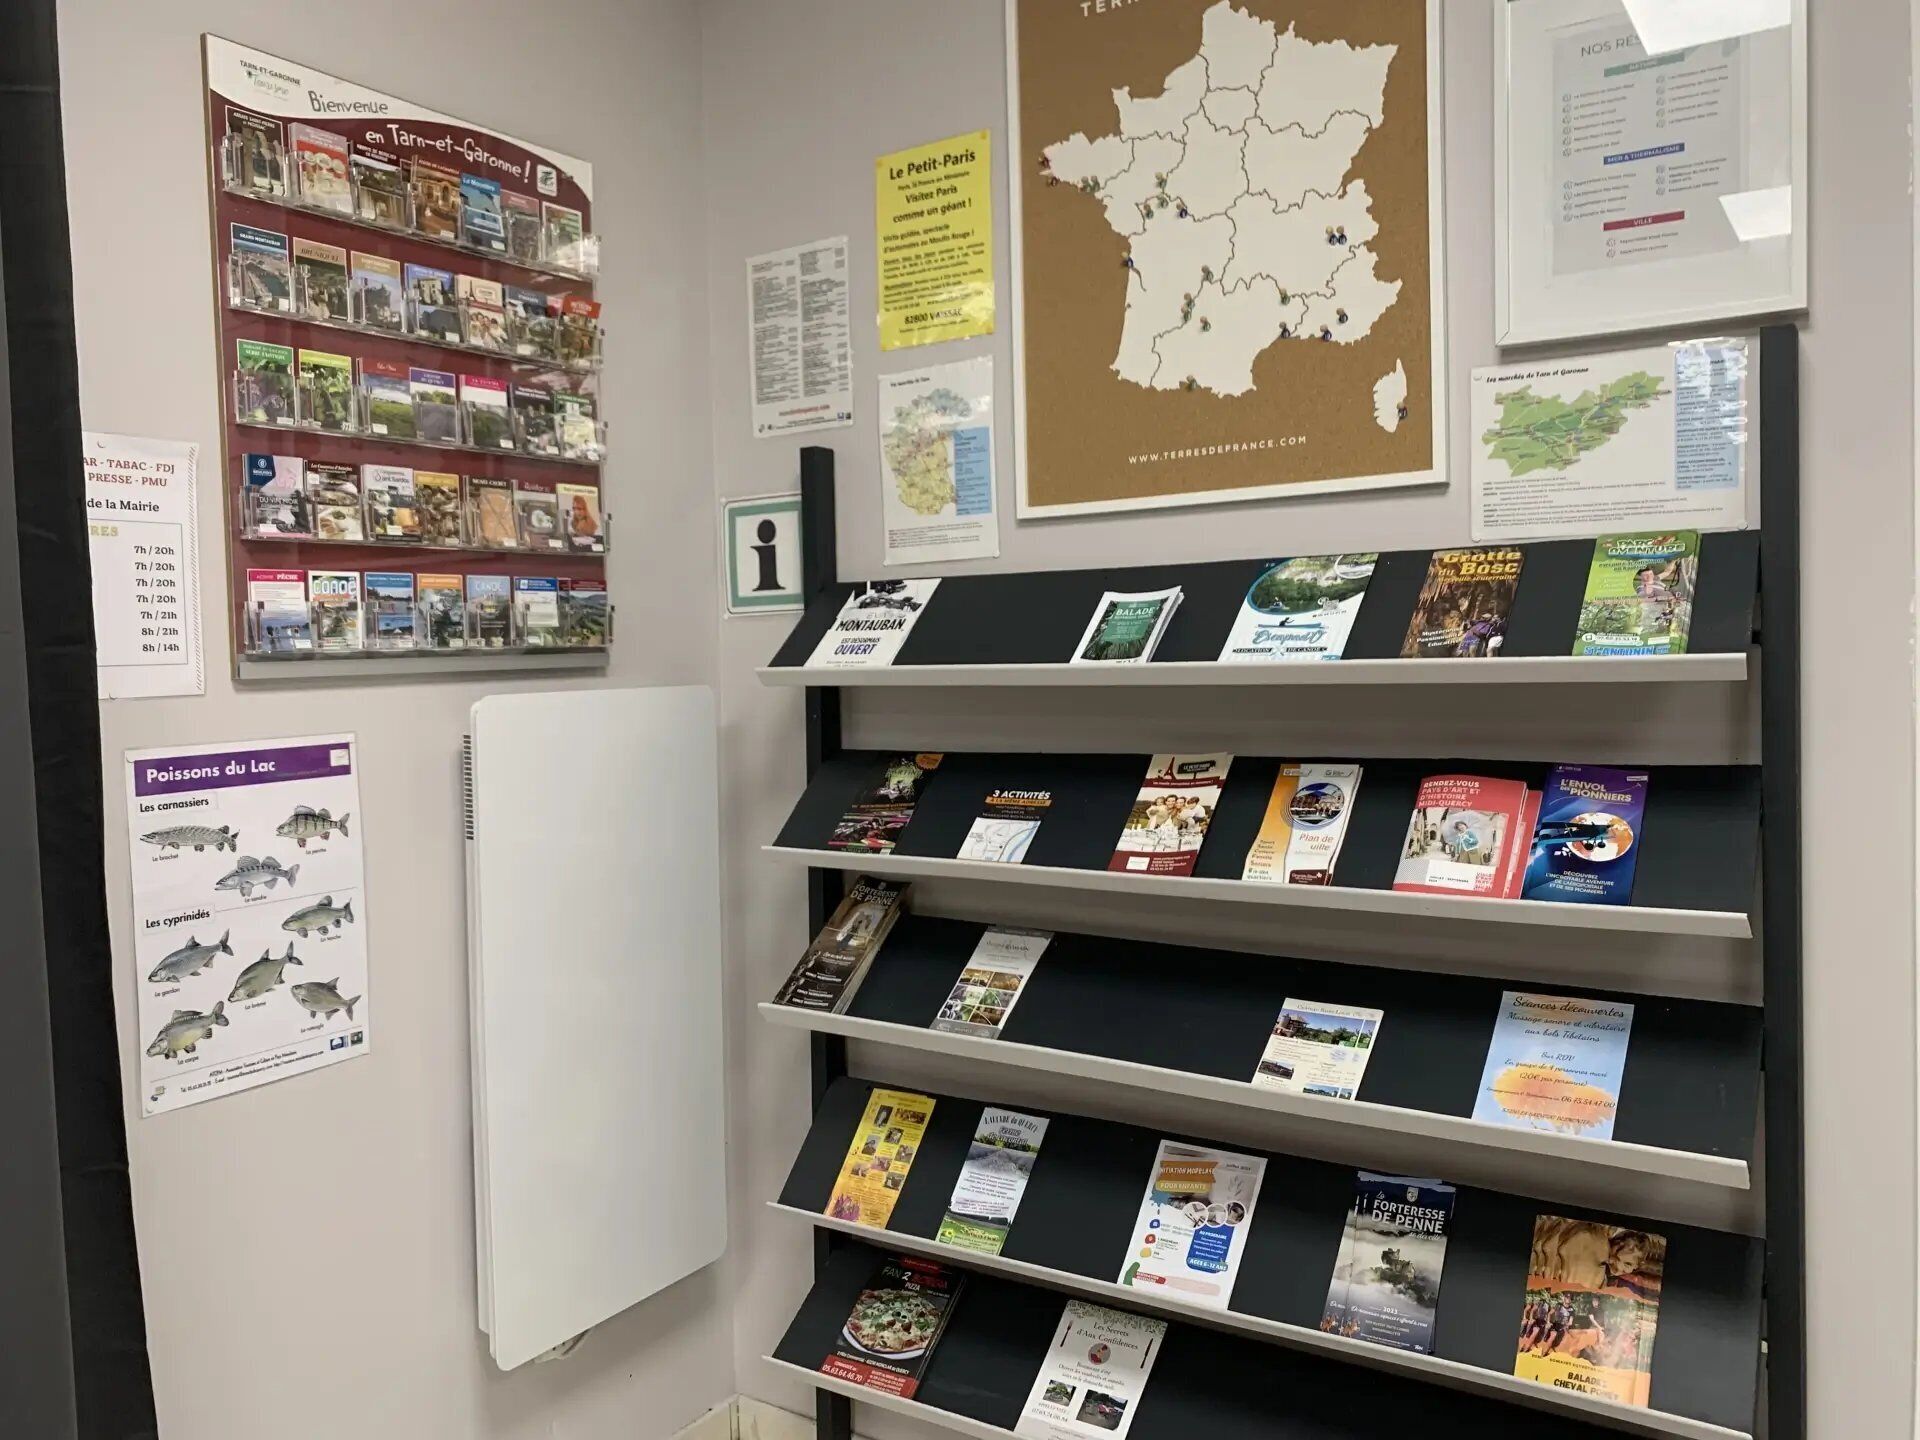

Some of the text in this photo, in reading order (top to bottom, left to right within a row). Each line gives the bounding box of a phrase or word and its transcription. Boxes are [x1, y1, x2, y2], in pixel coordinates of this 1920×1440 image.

[1581, 43, 1611, 57] NOS
[240, 60, 301, 85] TARN-ET-GARONNE
[308, 90, 389, 114] Bienvenue
[365, 131, 384, 144] en
[387, 124, 522, 178] Tarn-et-Garonne
[890, 149, 975, 180] Le Petit-Paris
[906, 184, 958, 204] Visitez Paris
[893, 209, 924, 223] comme
[927, 206, 938, 216] un
[941, 200, 966, 216] géant
[1634, 217, 1653, 226] VILLE
[1486, 375, 1497, 383] Les
[1498, 372, 1525, 382] marchés
[1527, 371, 1534, 379] de
[1560, 366, 1589, 376] Garonne
[1128, 436, 1307, 464] WWW.TERRESDEFRANCE.COM
[107, 459, 147, 471] TABAC
[156, 464, 175, 474] FDJ
[88, 473, 167, 486] PRESSE PMU
[87, 498, 160, 512] de la Mairie
[134, 545, 174, 555] 7h 20h
[1608, 543, 1685, 555] AVENTURE
[1444, 551, 1521, 563] Grotte
[135, 562, 175, 571] 7h 20h
[1439, 562, 1518, 576] du Bosc
[136, 578, 176, 587] 7h 20h
[136, 594, 176, 603] 7h 20h
[141, 611, 177, 620] 7h 21h
[142, 627, 178, 636] 8h 21h
[836, 618, 906, 631] MONTAUBAN
[142, 643, 180, 652] 8h 14h
[834, 644, 877, 655] OUVERT
[147, 760, 276, 784] Poissons du Lac
[1424, 780, 1479, 788] RENDEZ-VOUS
[1560, 778, 1606, 792] L'ENVOL
[1000, 790, 1050, 800] ACTIVITÉS
[1570, 788, 1632, 802] PIONNIERS
[140, 798, 209, 812] Les carnassiers
[1300, 832, 1318, 841] Plan
[1564, 869, 1598, 879] DÉCOUVREZ
[850, 890, 894, 905] DE PENNE
[854, 884, 898, 897] FORTERESSE
[146, 910, 210, 928] Les cyprinidés
[1513, 996, 1624, 1018] Séances découvertes
[1506, 1012, 1542, 1023] Massage
[1543, 1019, 1572, 1027] sonore
[1584, 1020, 1626, 1032] vibratoire
[1543, 1028, 1559, 1038] bols
[1562, 1030, 1600, 1042] Tibétains
[1556, 1053, 1575, 1062] RDV
[1516, 1061, 1537, 1070] groupe
[1554, 1067, 1588, 1077] personnes
[1377, 1190, 1385, 1200] La
[1373, 1200, 1446, 1221] FORTERESSE
[1371, 1209, 1444, 1234] DE PENNE
[882, 1266, 912, 1281] FAN 2
[905, 1282, 921, 1291] PIZZA
[1383, 1306, 1398, 1314] 2023
[1093, 1322, 1129, 1337] Les Secrets
[1076, 1328, 1138, 1350] d'Aux Confidences
[1554, 1378, 1588, 1393] CHEVAL
